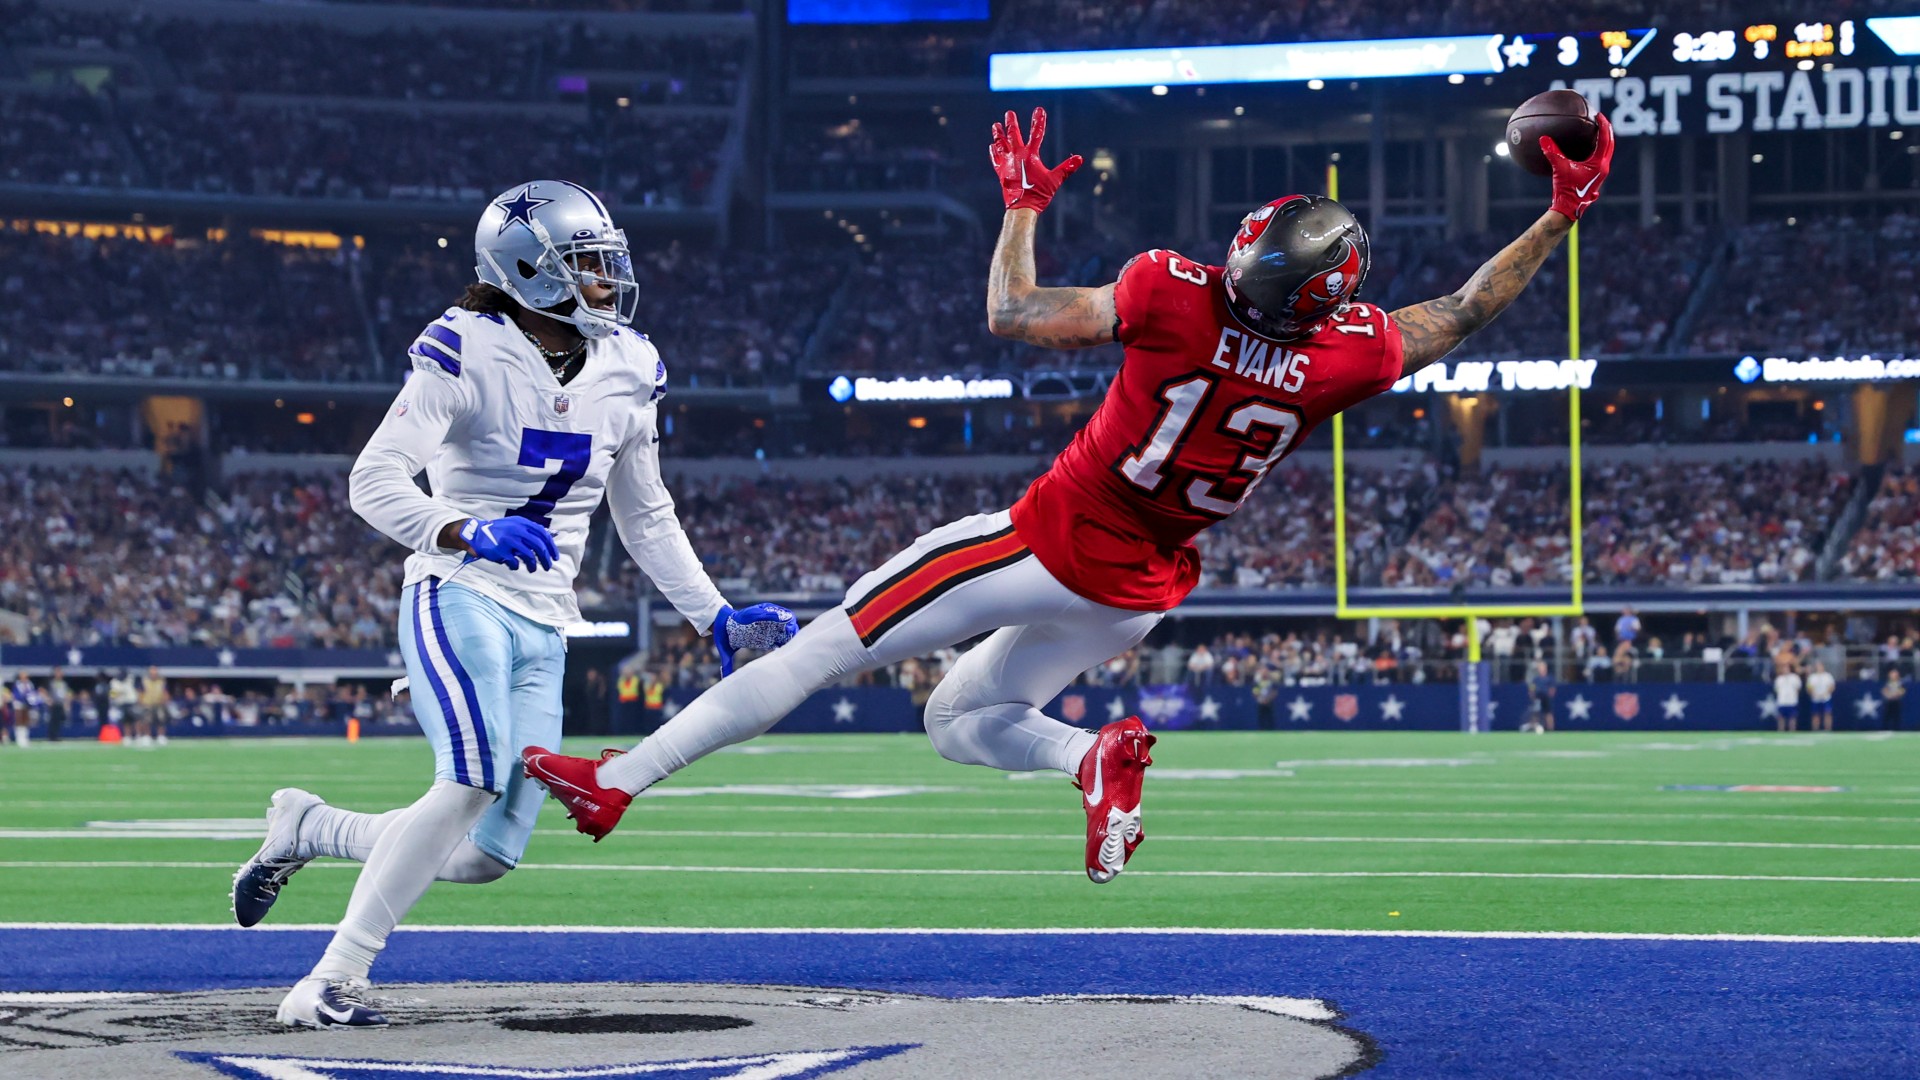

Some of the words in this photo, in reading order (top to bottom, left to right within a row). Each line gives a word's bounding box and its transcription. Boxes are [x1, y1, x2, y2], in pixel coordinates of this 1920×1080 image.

[1558, 36, 1578, 65] 3
[1549, 76, 1691, 137] T&T
[1211, 326, 1310, 393] EVANS
[505, 427, 593, 528] 7
[1112, 372, 1304, 517] 13
